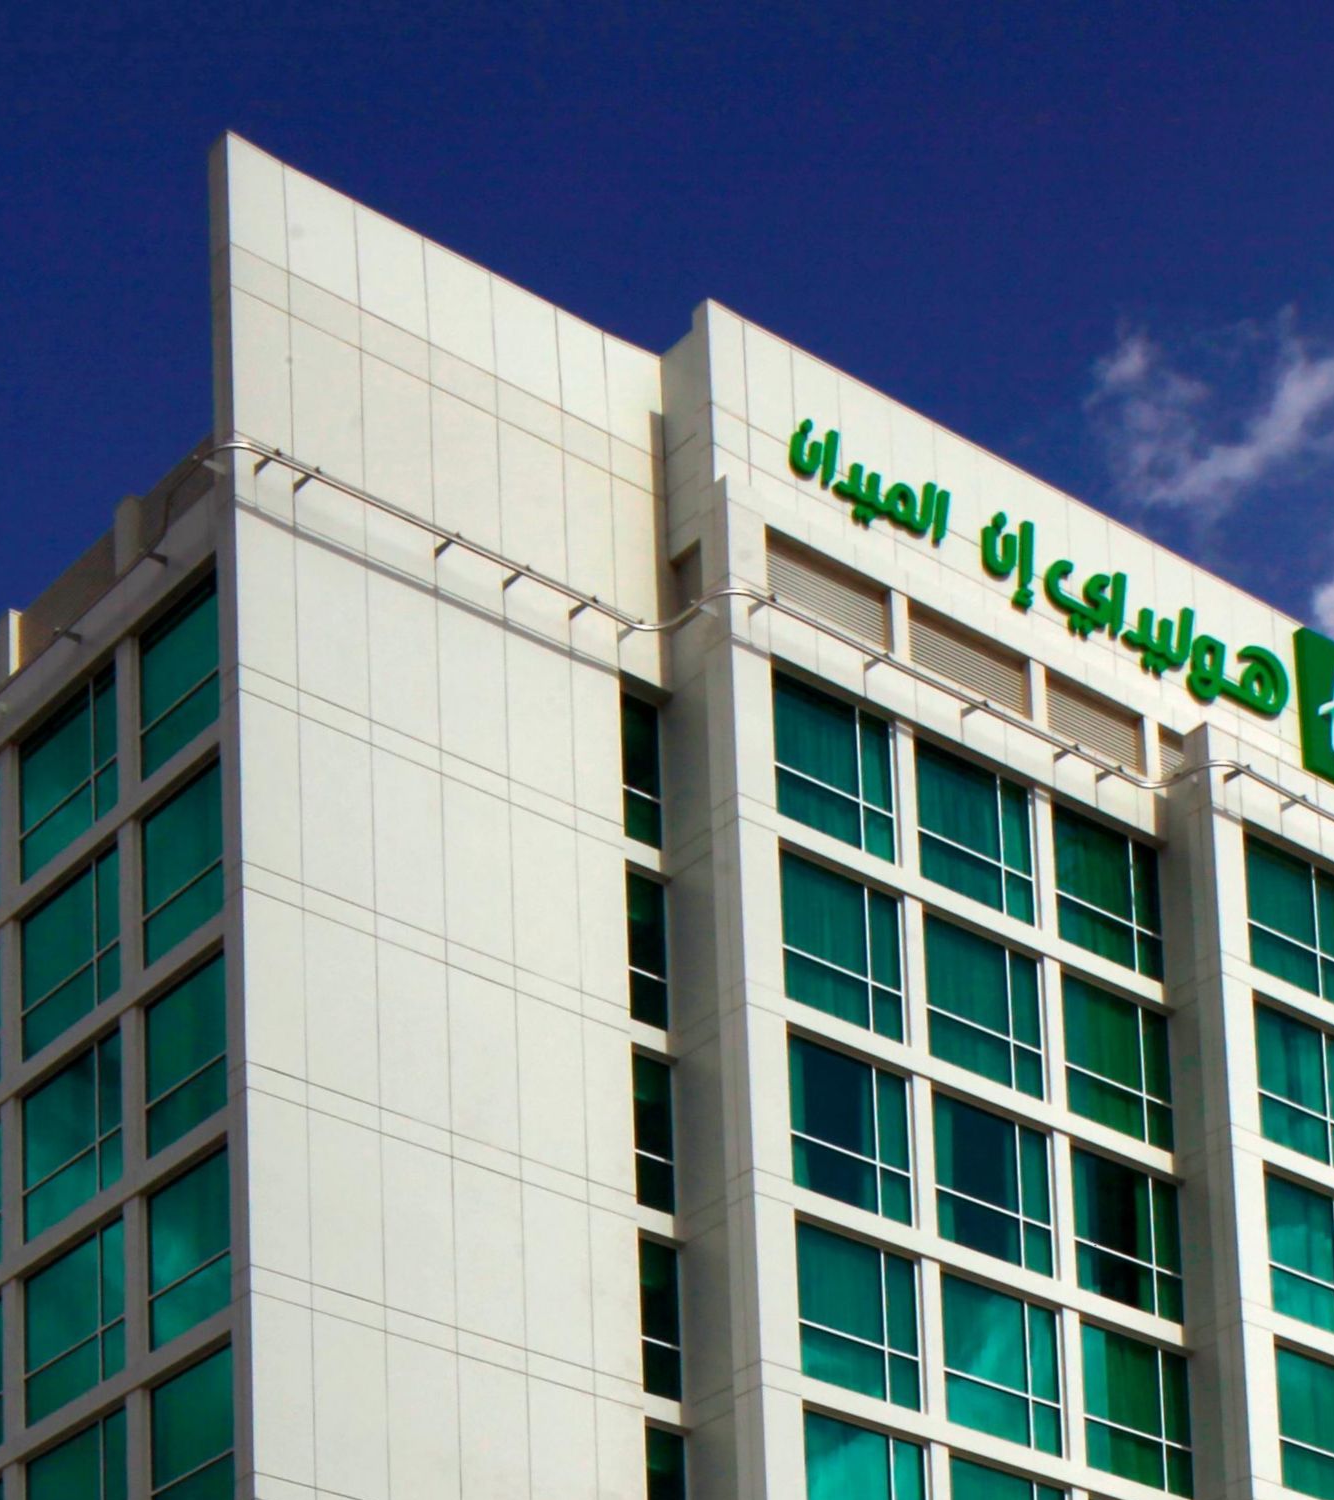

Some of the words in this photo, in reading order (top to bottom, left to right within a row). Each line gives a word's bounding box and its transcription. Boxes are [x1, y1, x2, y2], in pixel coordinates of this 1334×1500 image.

[789, 419, 952, 547] الميدان
[980, 511, 1035, 611] إن
[1044, 558, 1290, 718] هوليداي
